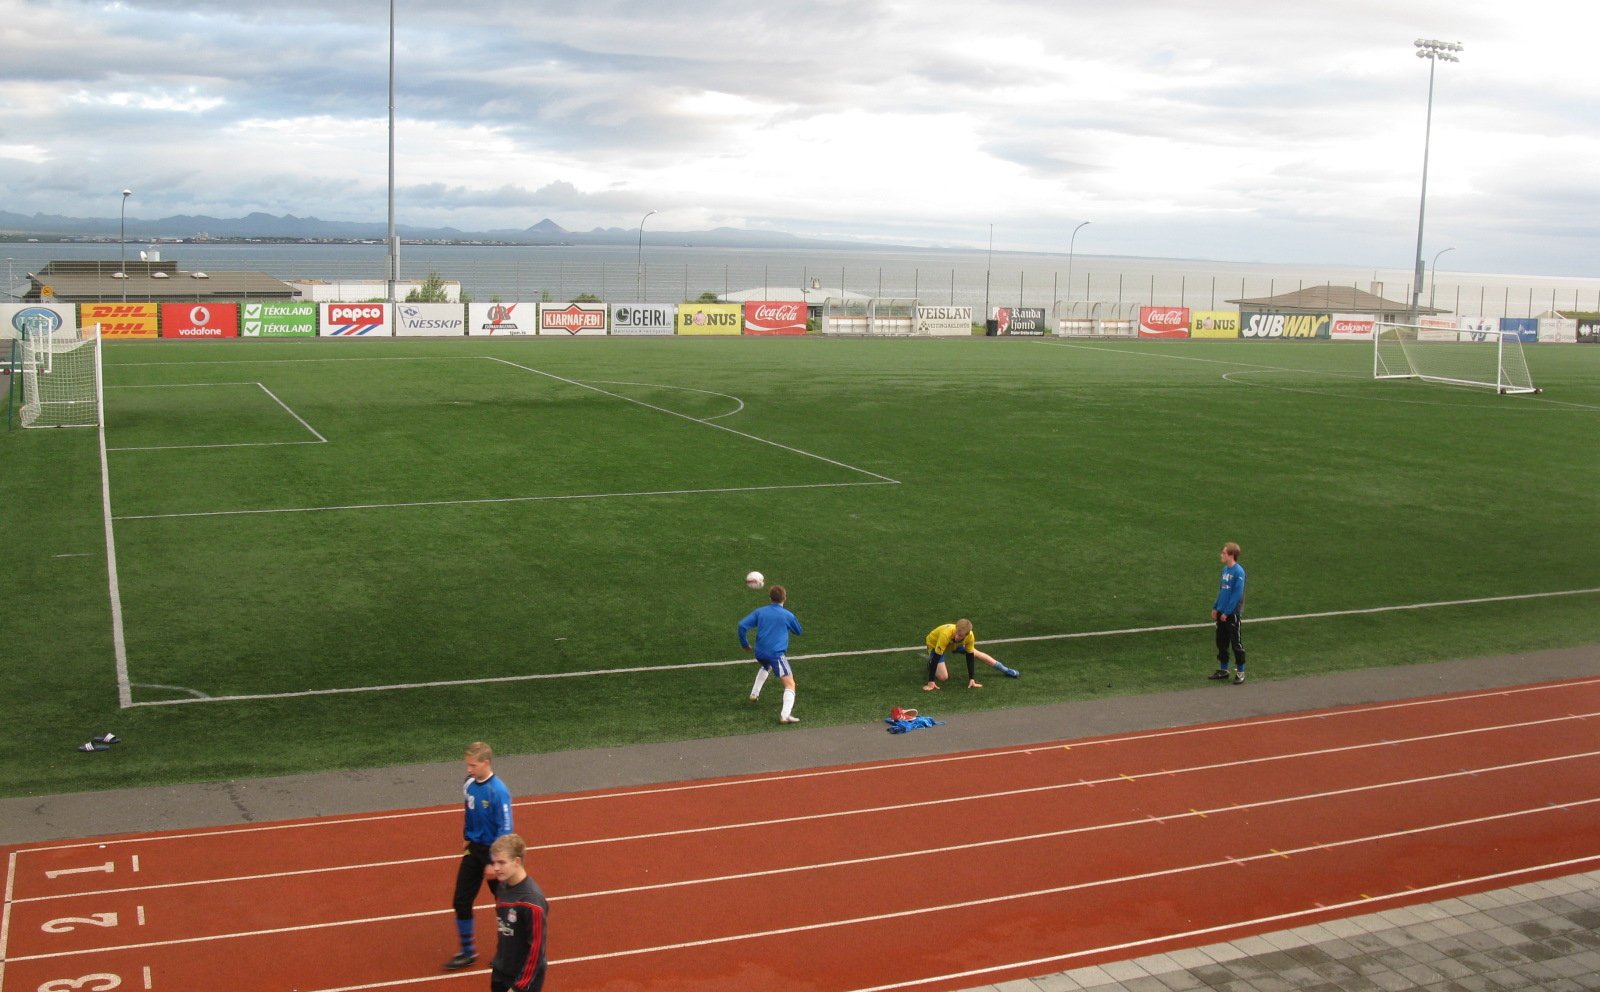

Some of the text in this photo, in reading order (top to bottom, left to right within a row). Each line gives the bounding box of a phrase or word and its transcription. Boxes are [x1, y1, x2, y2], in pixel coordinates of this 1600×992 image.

[92, 306, 147, 317] DHL
[263, 306, 313, 316] TÉKKLAND
[332, 308, 381, 322] papco
[755, 305, 799, 320] Coca-Cola
[918, 308, 971, 320] VEISLAN
[633, 309, 666, 326] GEIRI
[1148, 310, 1183, 325] Coca-Cola
[101, 323, 147, 335] DHL
[263, 323, 312, 333] TÉKKLAND
[408, 320, 462, 329] NESSKIP
[1242, 314, 1329, 338] SUBWAY
[1336, 322, 1371, 334] Colgate
[179, 327, 221, 335] vodafone
[45, 862, 114, 878] 1
[41, 912, 118, 933] 2
